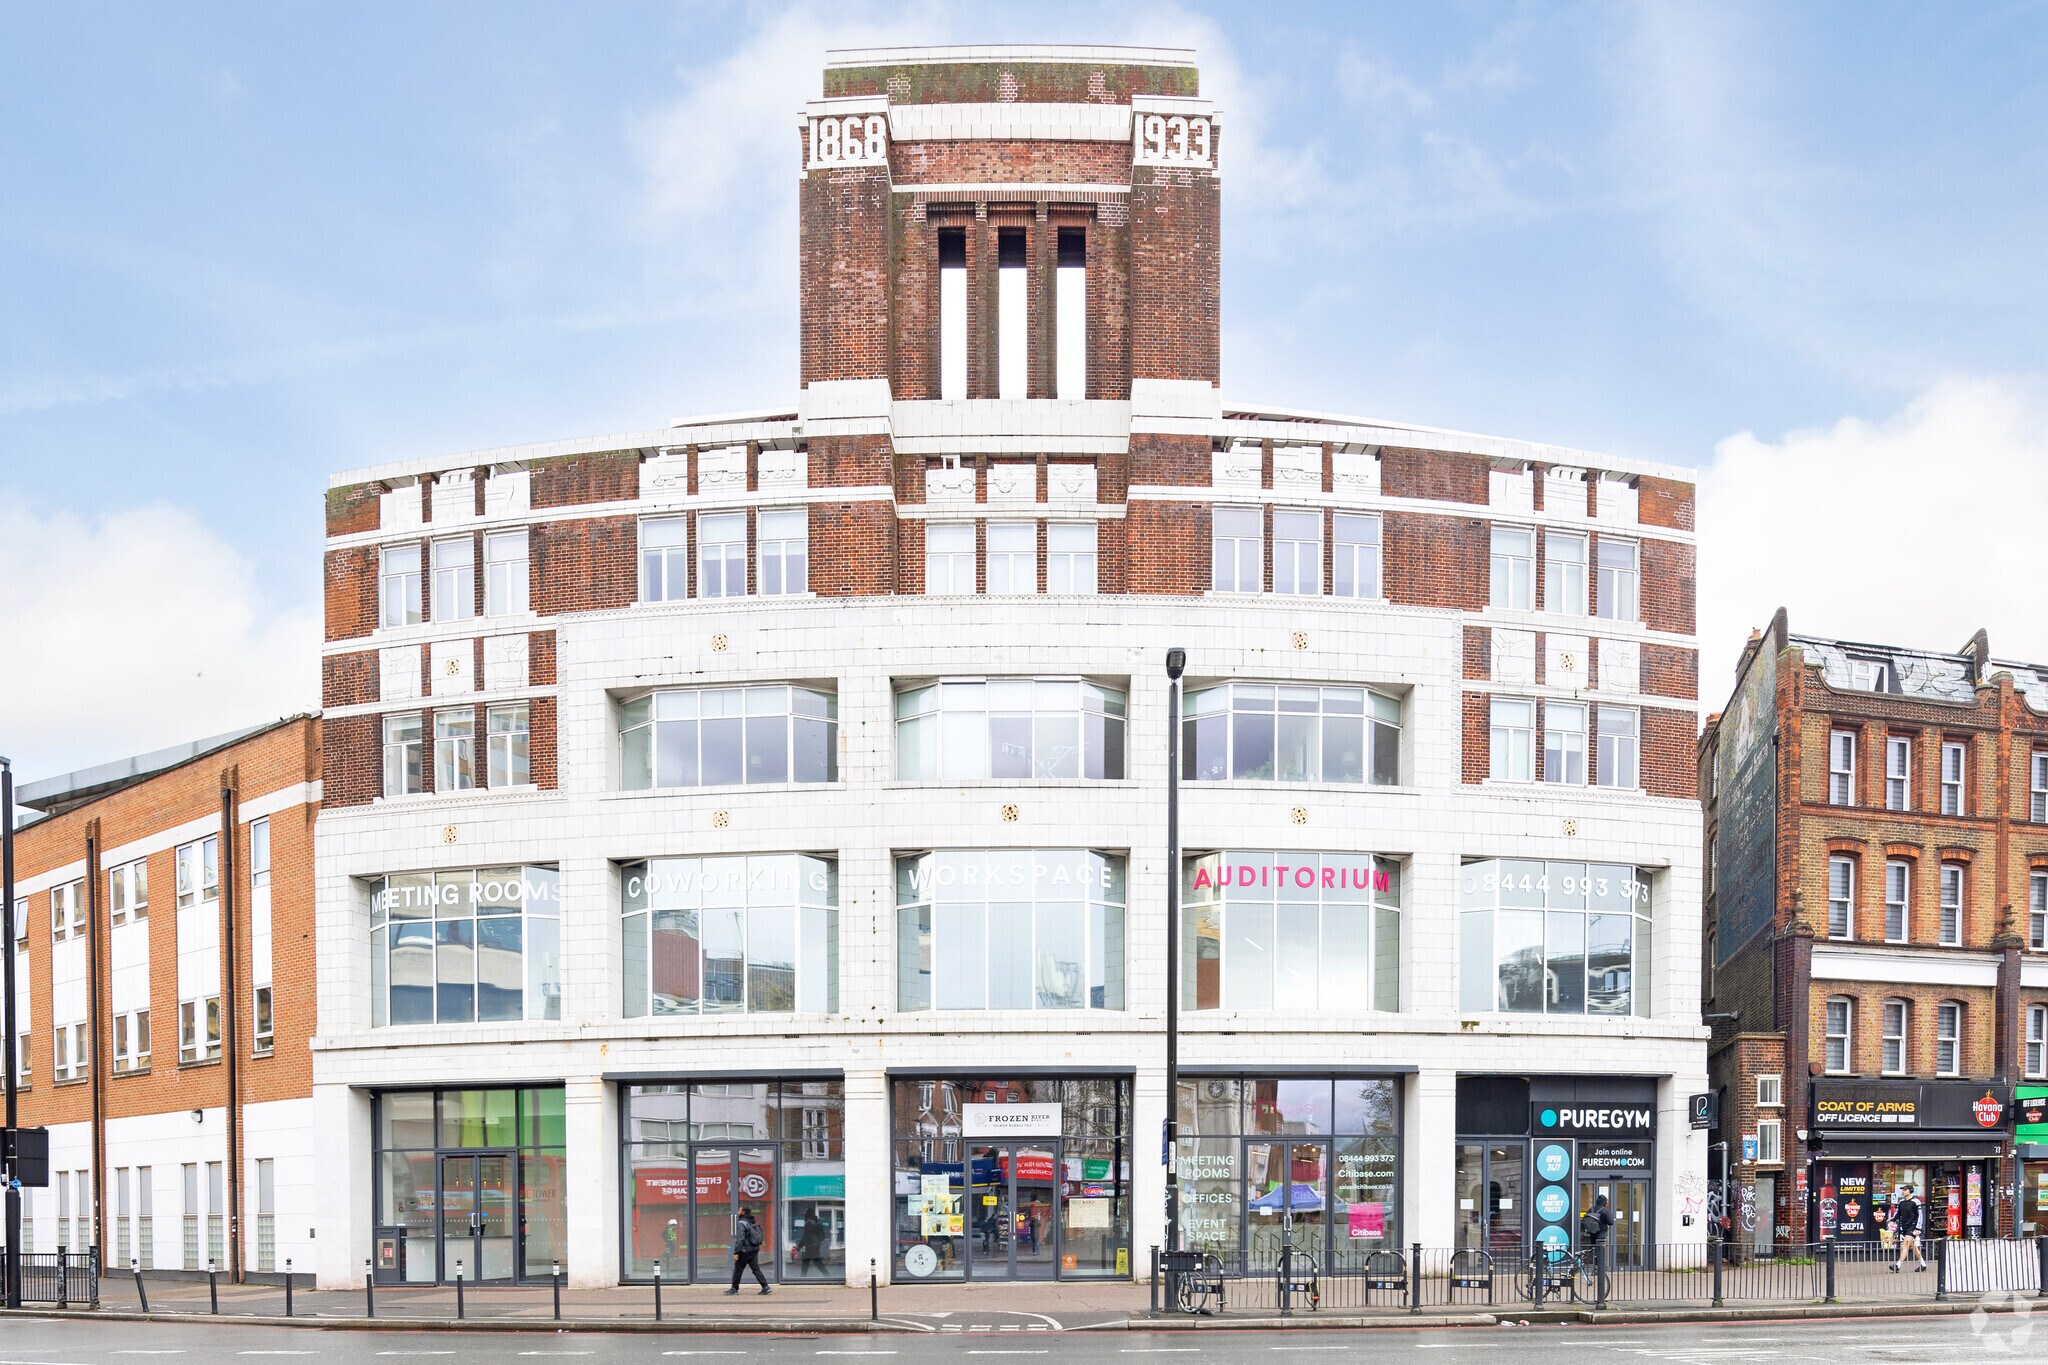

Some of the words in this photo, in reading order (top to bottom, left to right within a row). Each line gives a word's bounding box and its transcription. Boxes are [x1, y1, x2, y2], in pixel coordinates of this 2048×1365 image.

[809, 114, 887, 163] 1868
[1135, 114, 1212, 162] 1933
[908, 863, 1113, 889] WORKSPACE
[1193, 865, 1391, 894] AUDITORIUM
[628, 869, 829, 898] COWORKING
[1462, 873, 1550, 895] 08444
[1562, 875, 1609, 898] 993
[1619, 879, 1649, 903] 373
[371, 883, 460, 913] MEETING
[1817, 1101, 1852, 1112] COAT
[1855, 1101, 1875, 1112] OF
[1876, 1101, 1915, 1112] ARMS
[1972, 1101, 2003, 1112] Havana
[1559, 1109, 1650, 1128] PUREGYM
[1817, 1113, 1838, 1122] OFF
[1838, 1113, 1881, 1122] LICENCE
[1978, 1111, 1996, 1122] Club
[1594, 1148, 1610, 1156] Join
[1611, 1148, 1633, 1156] online
[1180, 1155, 1235, 1166] MEETING
[1546, 1155, 1562, 1163] OPEN
[1185, 1168, 1230, 1178] ROOMS
[1547, 1163, 1561, 1172] 24/7
[1338, 1169, 1395, 1178] Citibase.com
[1840, 1177, 1866, 1186] NEW
[1182, 1193, 1232, 1204] OFFICES
[1188, 1218, 1227, 1229] EVENT
[1840, 1222, 1864, 1231] SKEPTA
[1188, 1231, 1227, 1241] SPACE
